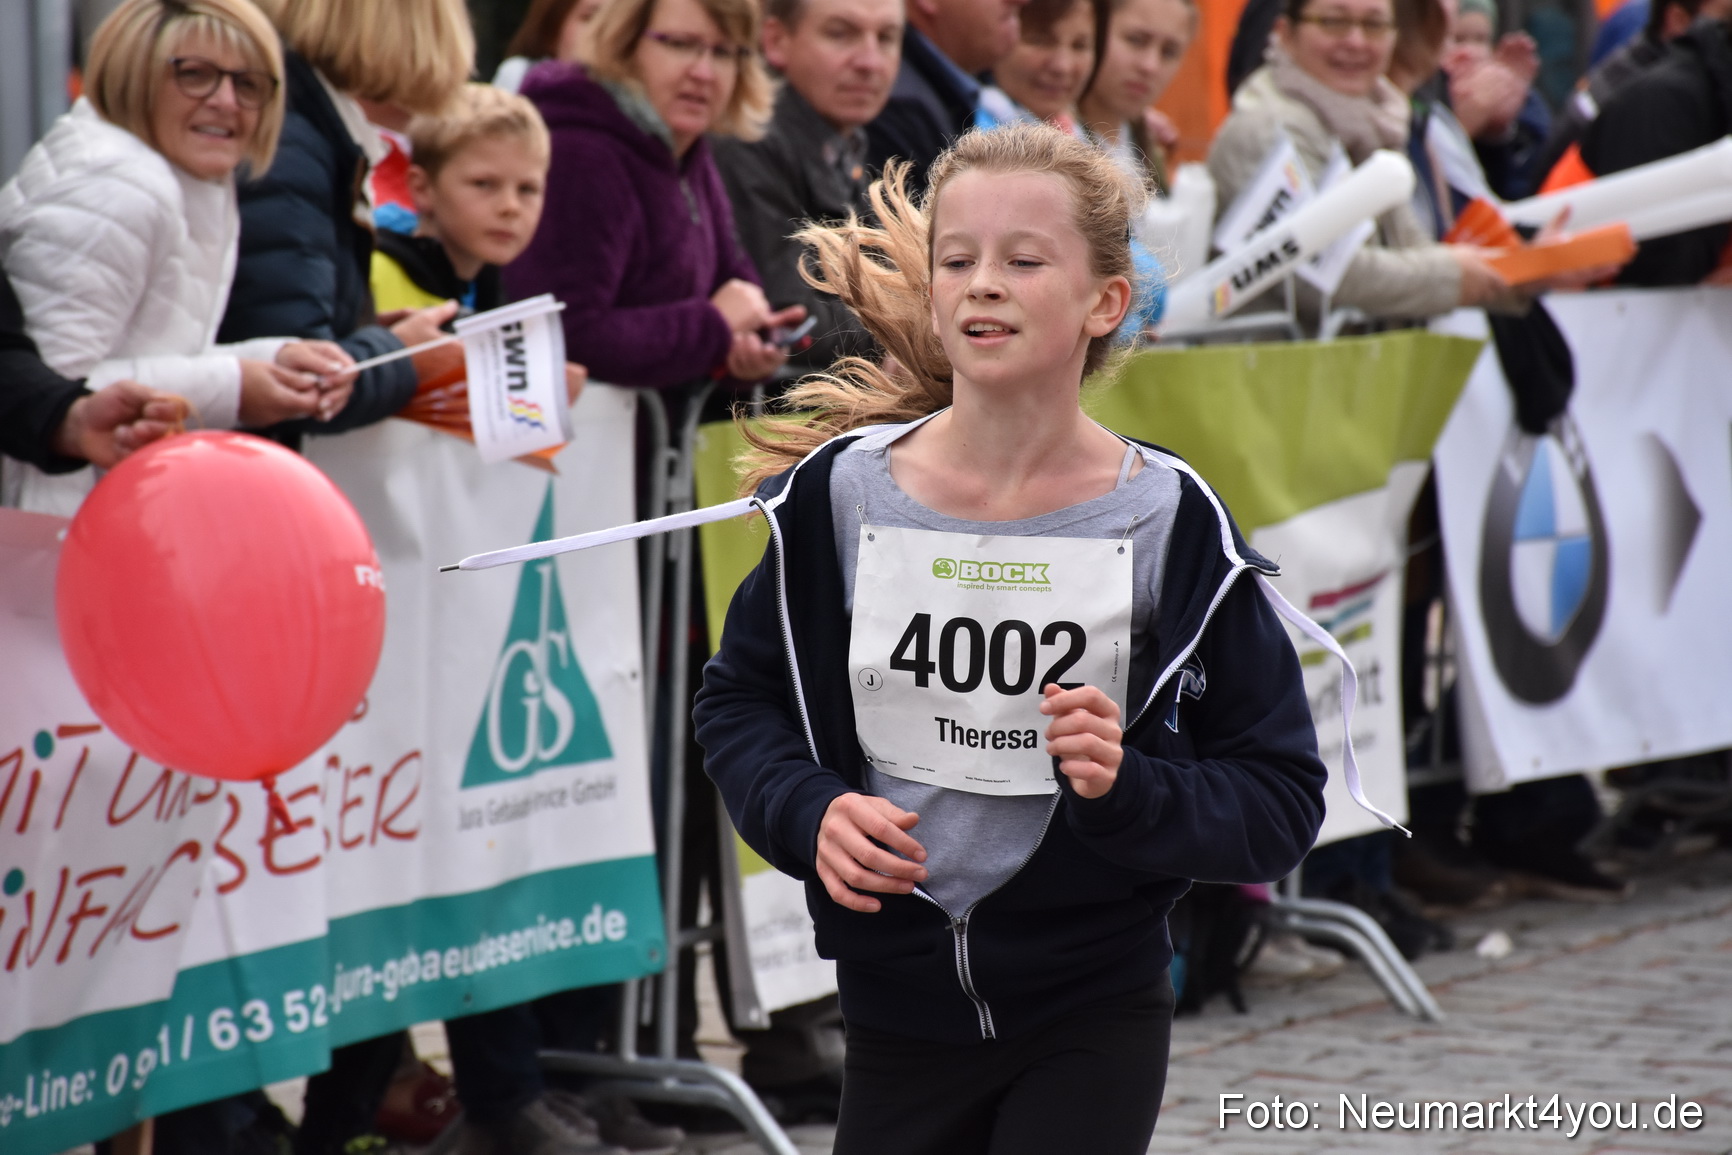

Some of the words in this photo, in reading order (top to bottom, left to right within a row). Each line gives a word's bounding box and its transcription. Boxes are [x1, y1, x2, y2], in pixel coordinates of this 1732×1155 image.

[959, 560, 1051, 584] BOCK
[957, 582, 984, 591] inspired
[890, 612, 1087, 695] 4002
[866, 674, 875, 686] J
[935, 716, 1038, 751] Theresa
